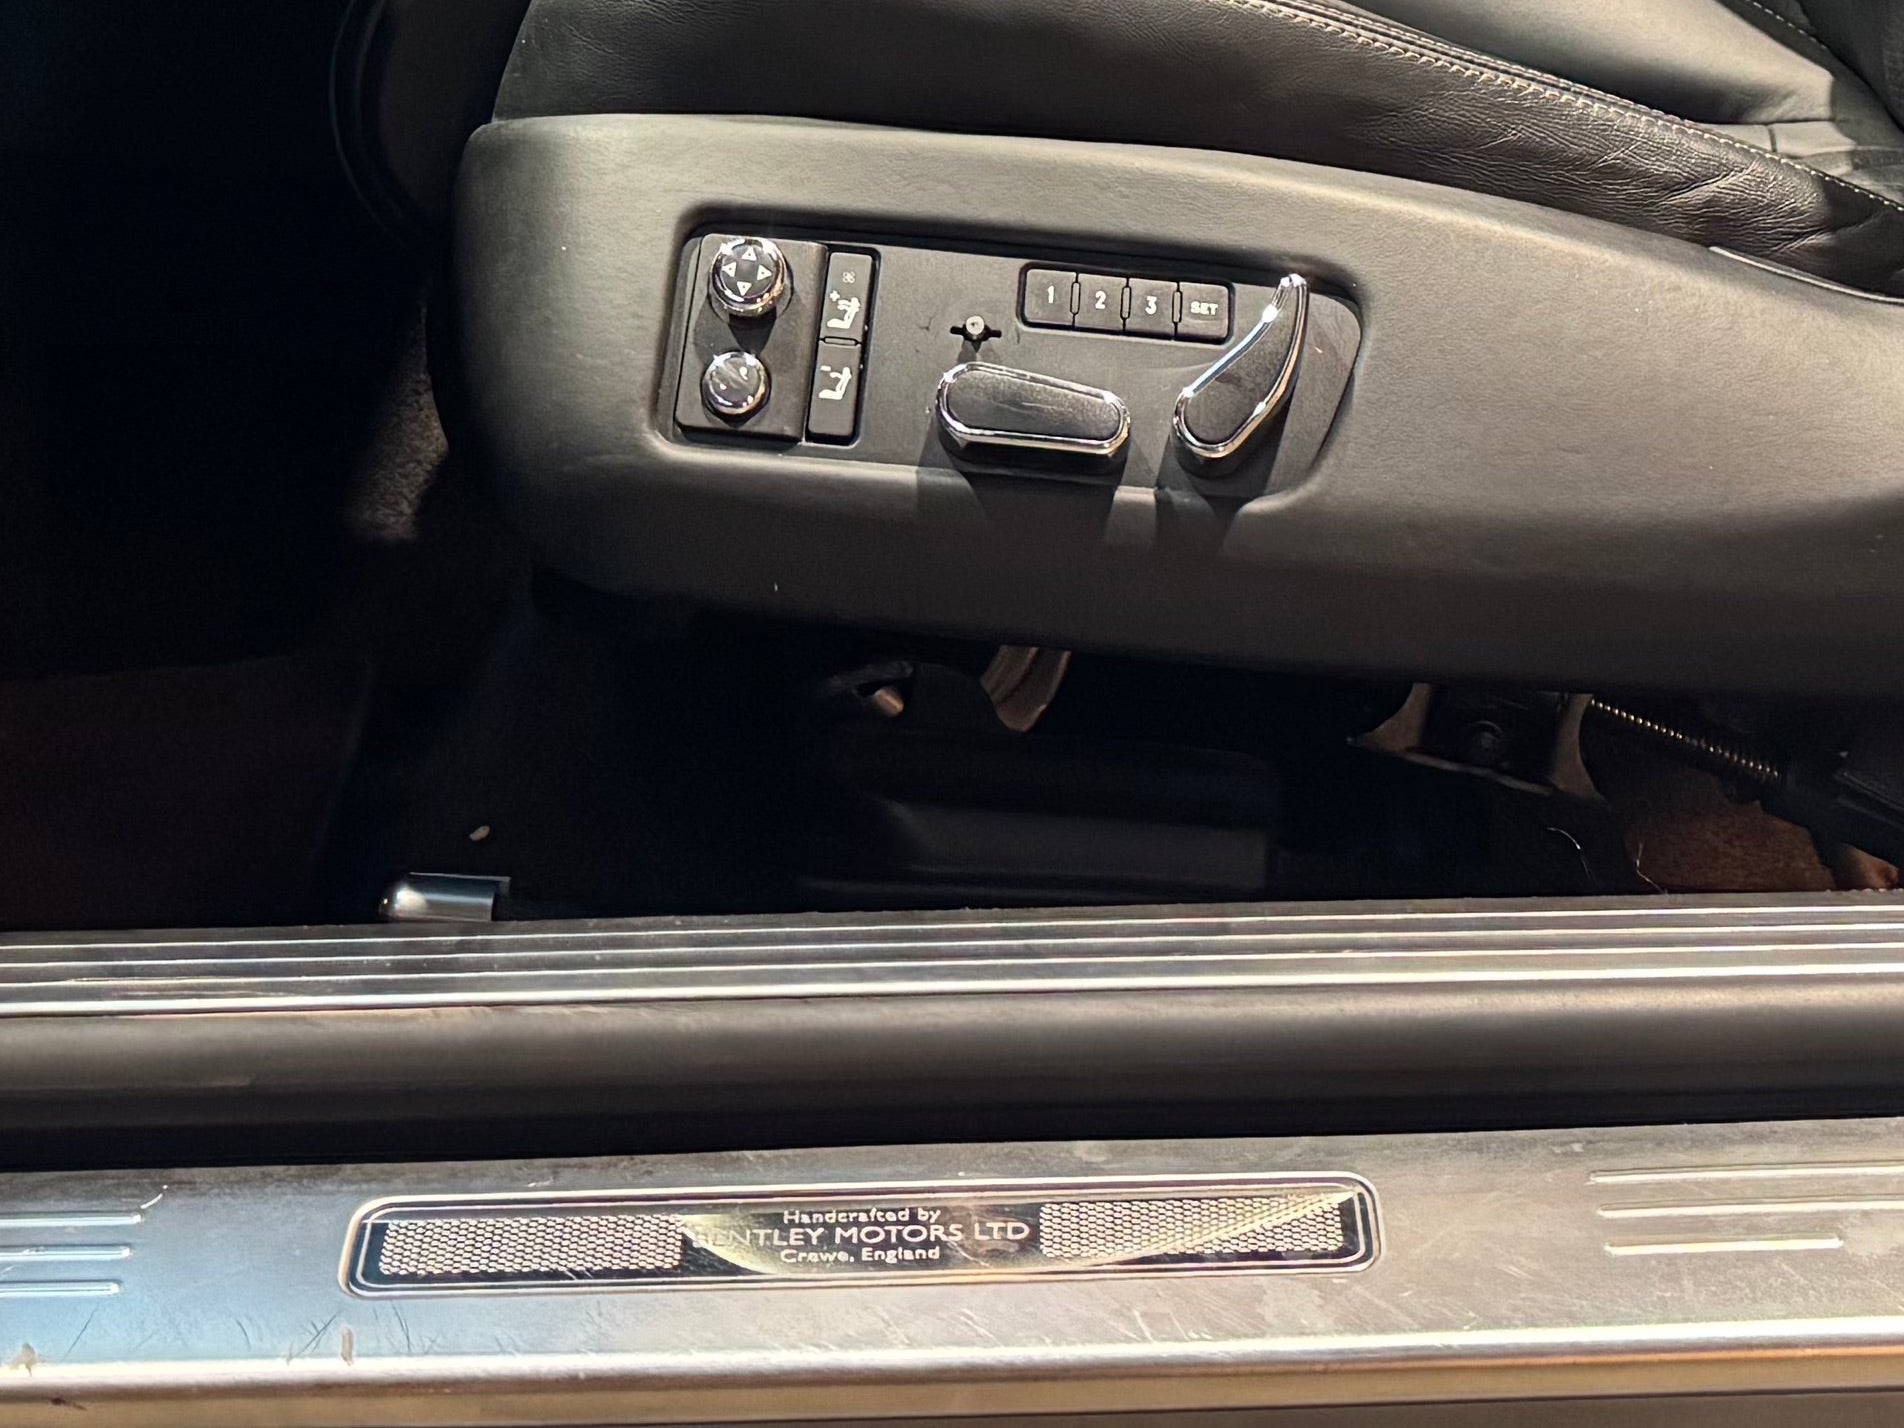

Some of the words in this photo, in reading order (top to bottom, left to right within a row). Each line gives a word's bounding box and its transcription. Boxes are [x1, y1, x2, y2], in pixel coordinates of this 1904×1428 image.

[1047, 285, 1055, 304] 1
[1095, 291, 1106, 309] 2
[1145, 296, 1157, 314] 3
[1190, 301, 1218, 316] SET
[783, 1207, 910, 1225] Handcrafted
[918, 1207, 941, 1224] by
[835, 1224, 962, 1246] MOTORS
[974, 1221, 1030, 1241] LTD
[861, 1246, 940, 1264] England
